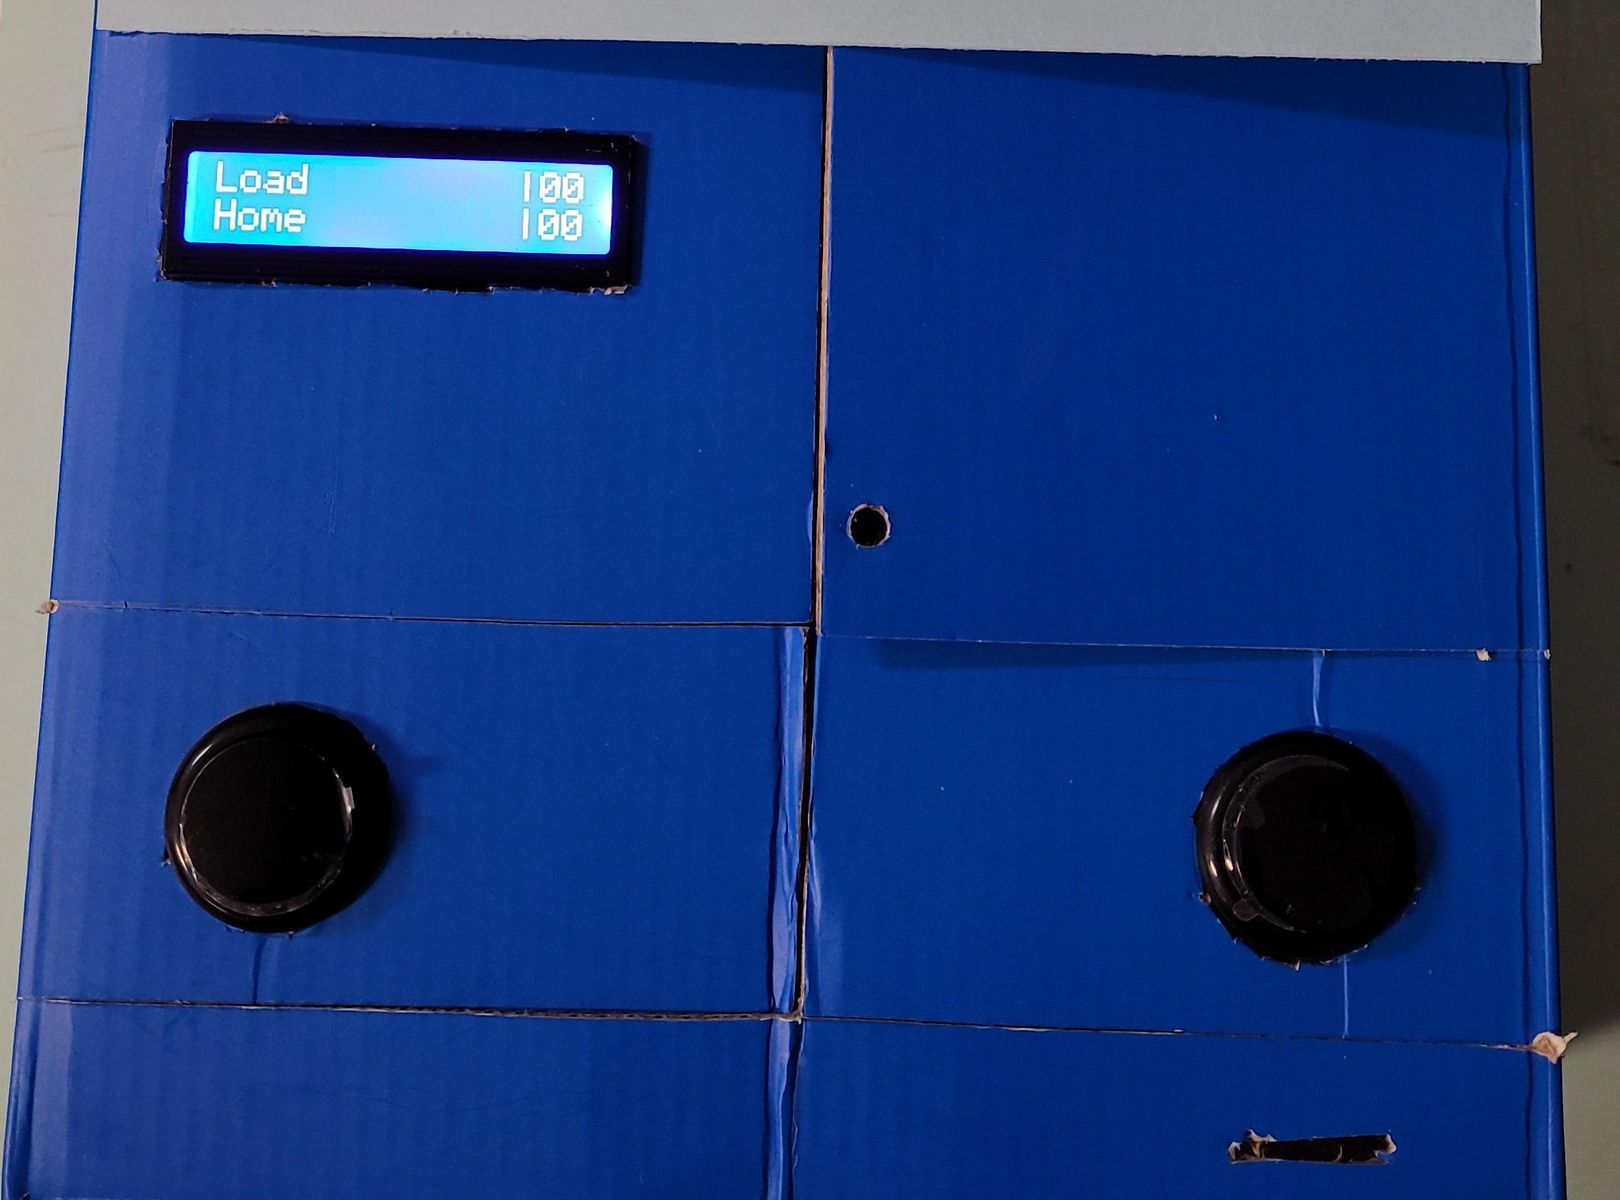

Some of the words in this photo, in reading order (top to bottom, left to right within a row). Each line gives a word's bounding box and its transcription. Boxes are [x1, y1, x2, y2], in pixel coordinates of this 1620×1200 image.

[214, 160, 310, 196] Load
[522, 170, 585, 204] 100
[212, 197, 307, 234] Home
[521, 207, 584, 242] 100
